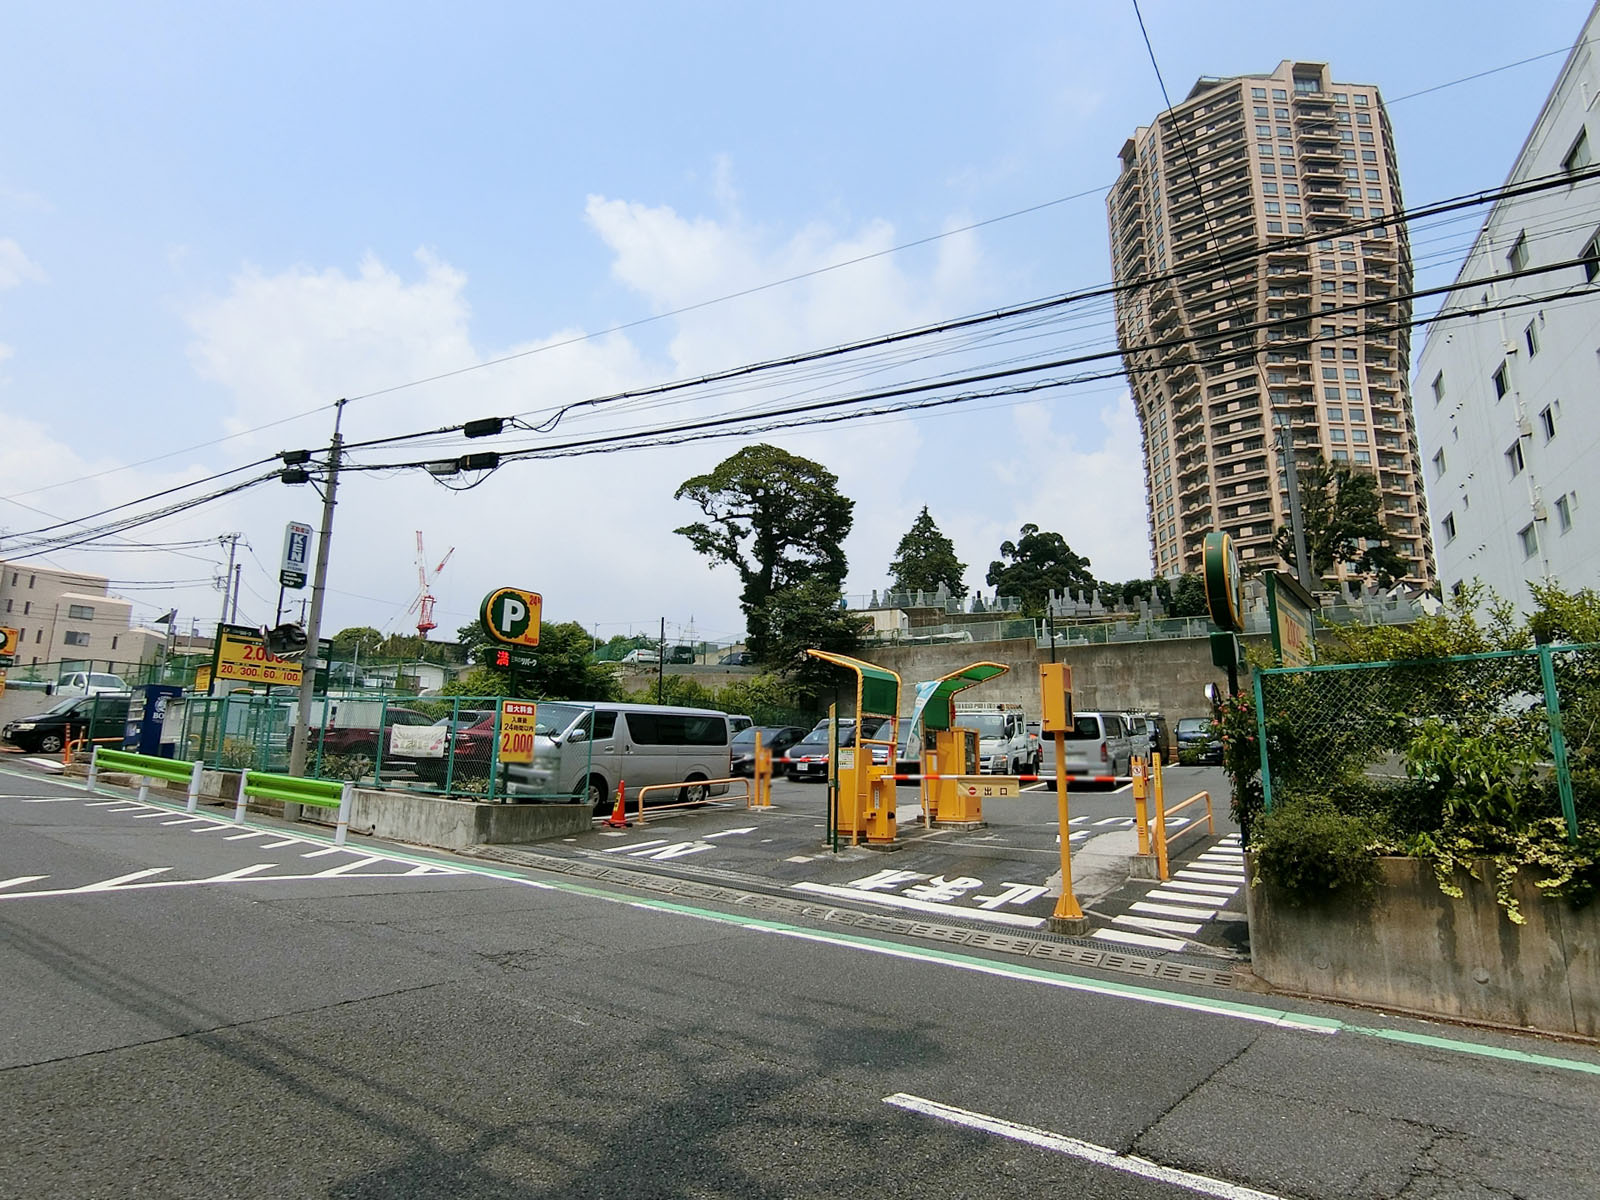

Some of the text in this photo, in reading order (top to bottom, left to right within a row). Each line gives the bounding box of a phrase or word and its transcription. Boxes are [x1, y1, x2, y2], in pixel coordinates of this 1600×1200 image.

[290, 534, 305, 562] KEN
[502, 598, 525, 632] P
[502, 733, 533, 753] 2,000
[984, 787, 1008, 796] 出口
